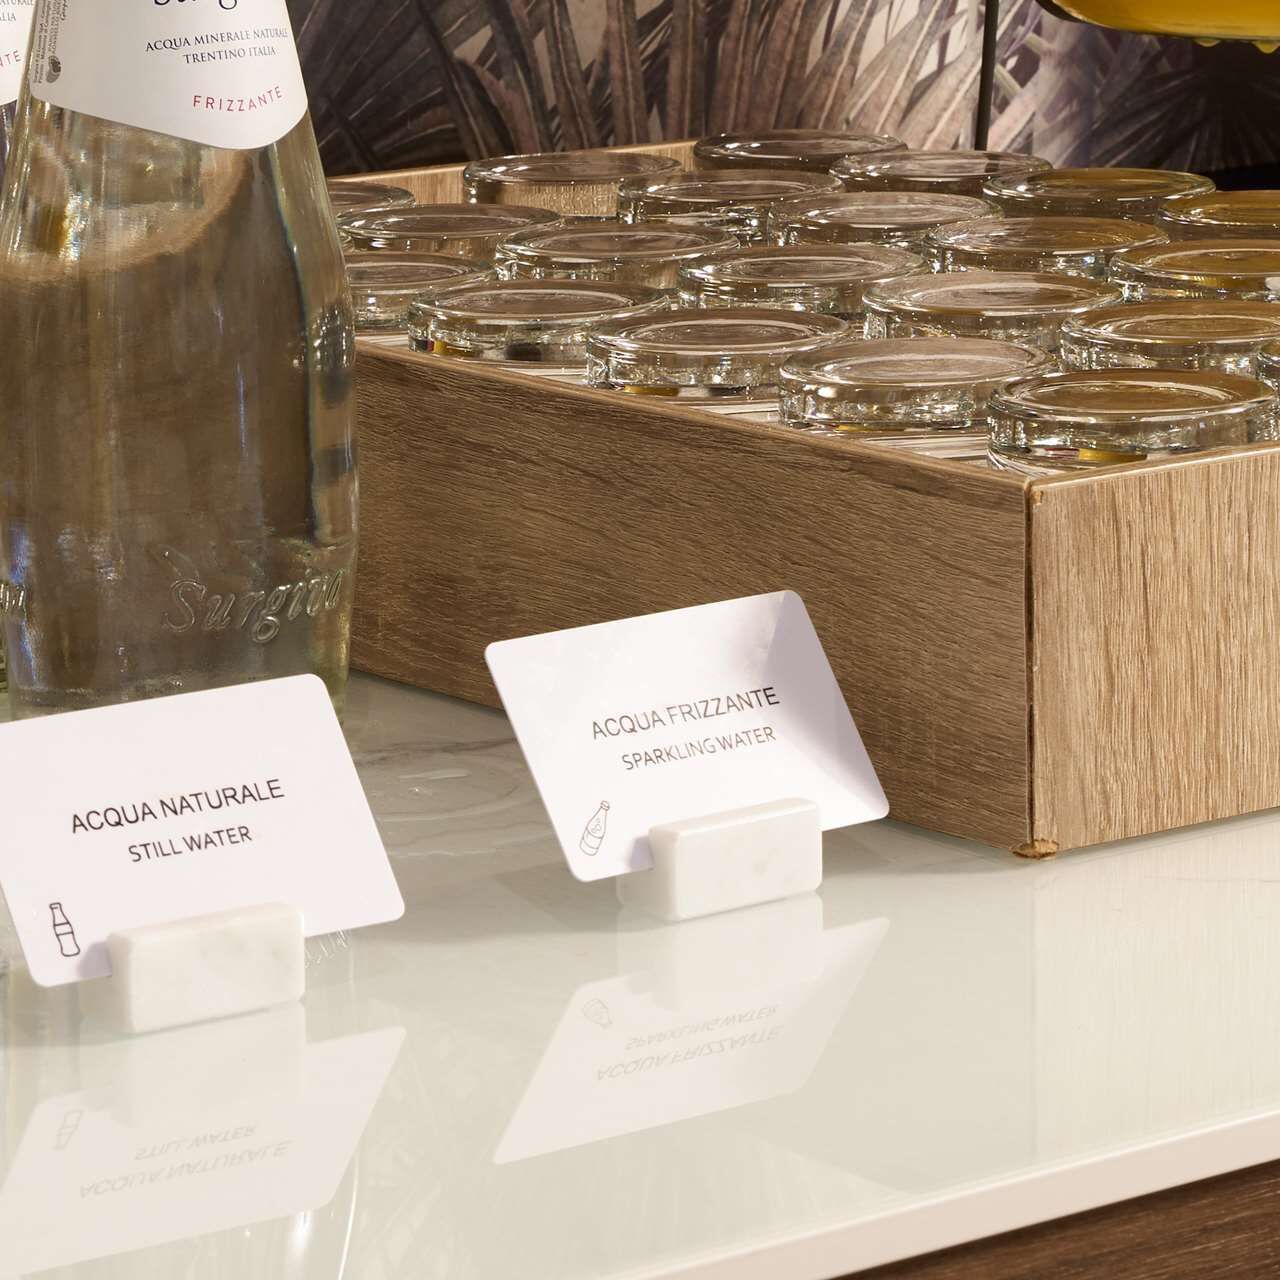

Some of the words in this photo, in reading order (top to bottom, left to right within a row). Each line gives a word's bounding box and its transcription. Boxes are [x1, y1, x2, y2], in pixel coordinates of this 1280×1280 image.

[145, 38, 191, 52] ACQUA
[194, 30, 250, 46] MINERALE
[183, 48, 246, 64] TRENTINO
[249, 46, 276, 57] ITALIA
[193, 86, 282, 112] FRIZZANTE
[592, 710, 665, 740] ACQUA
[666, 687, 780, 724] FRIZZANTE
[621, 737, 716, 770] SPARKLING
[715, 726, 776, 751] WATER
[72, 802, 157, 834] ACQUA
[159, 779, 285, 818] NATURALE
[128, 839, 183, 862] STILL
[182, 825, 252, 852] WATER
